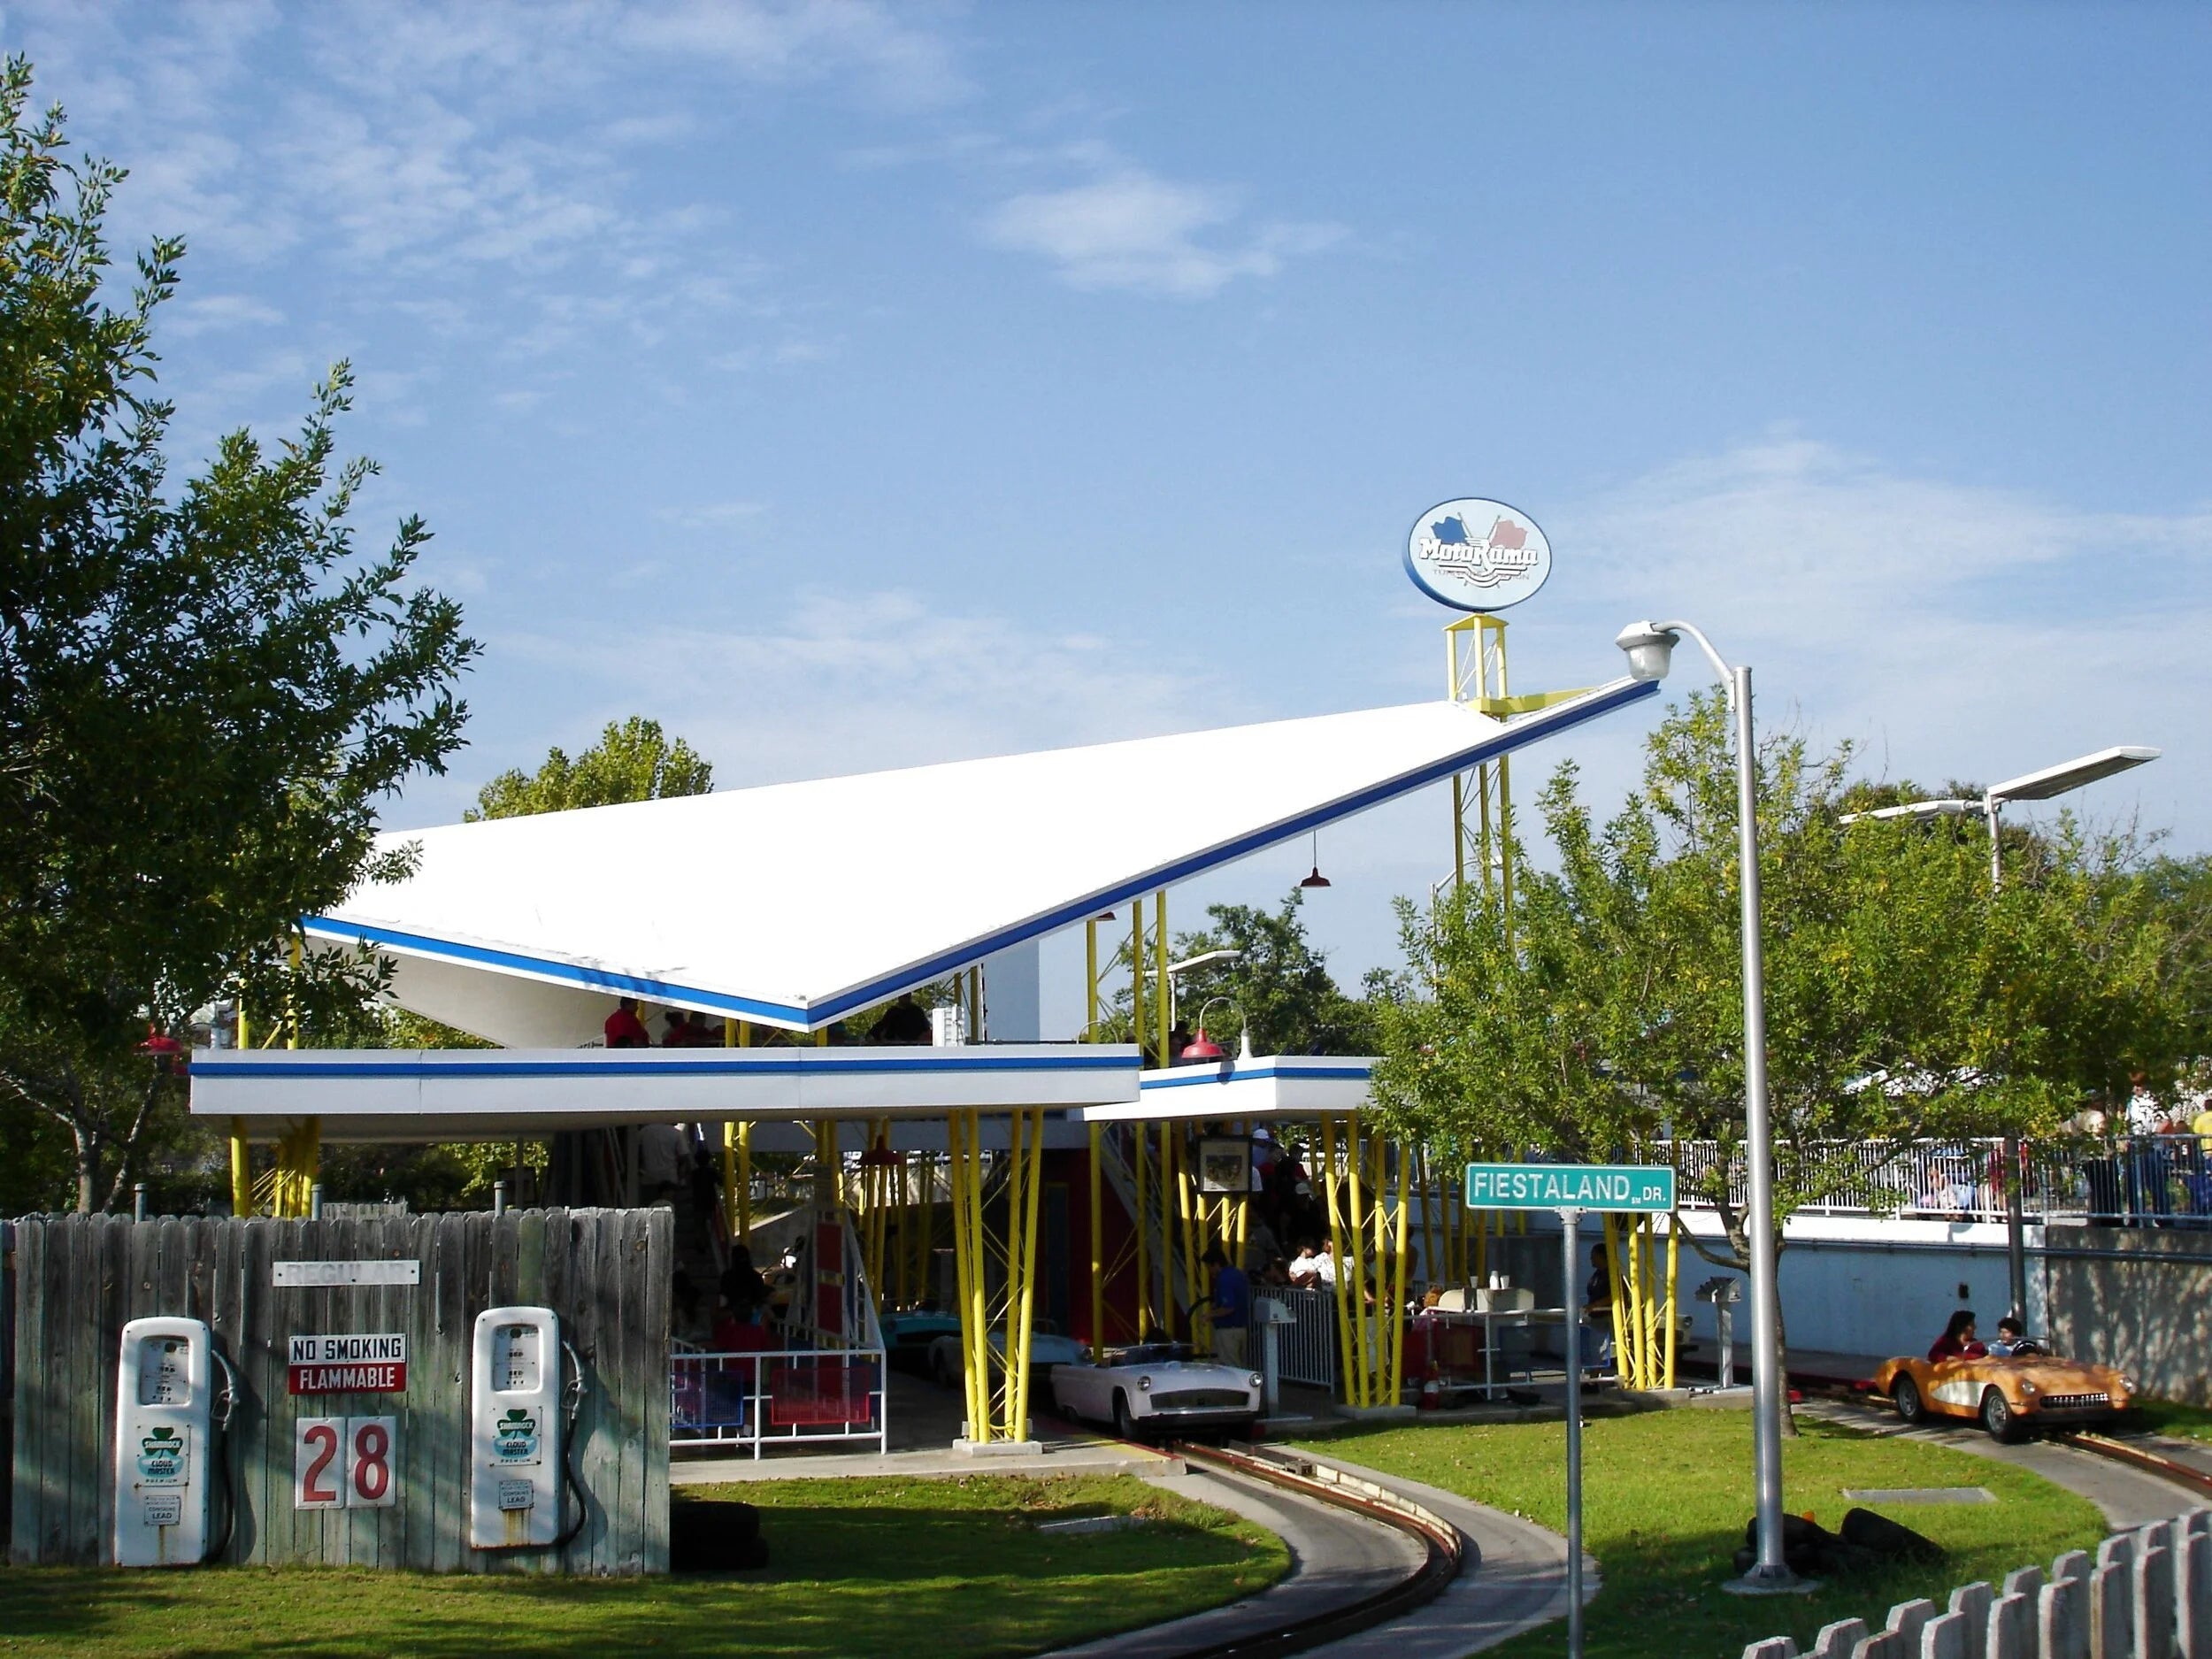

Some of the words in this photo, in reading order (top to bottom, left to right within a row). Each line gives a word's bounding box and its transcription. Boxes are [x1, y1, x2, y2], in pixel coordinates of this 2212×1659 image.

[1419, 537, 1538, 568] MotoRama
[1474, 1172, 1631, 1201] FIESTALAND
[1643, 1187, 1666, 1202] DR.
[286, 1263, 408, 1284] REGULAR
[294, 1340, 316, 1361] NO
[325, 1338, 402, 1359] SMOKING
[299, 1366, 396, 1390] FLAMMABLE
[303, 1423, 389, 1502] 28
